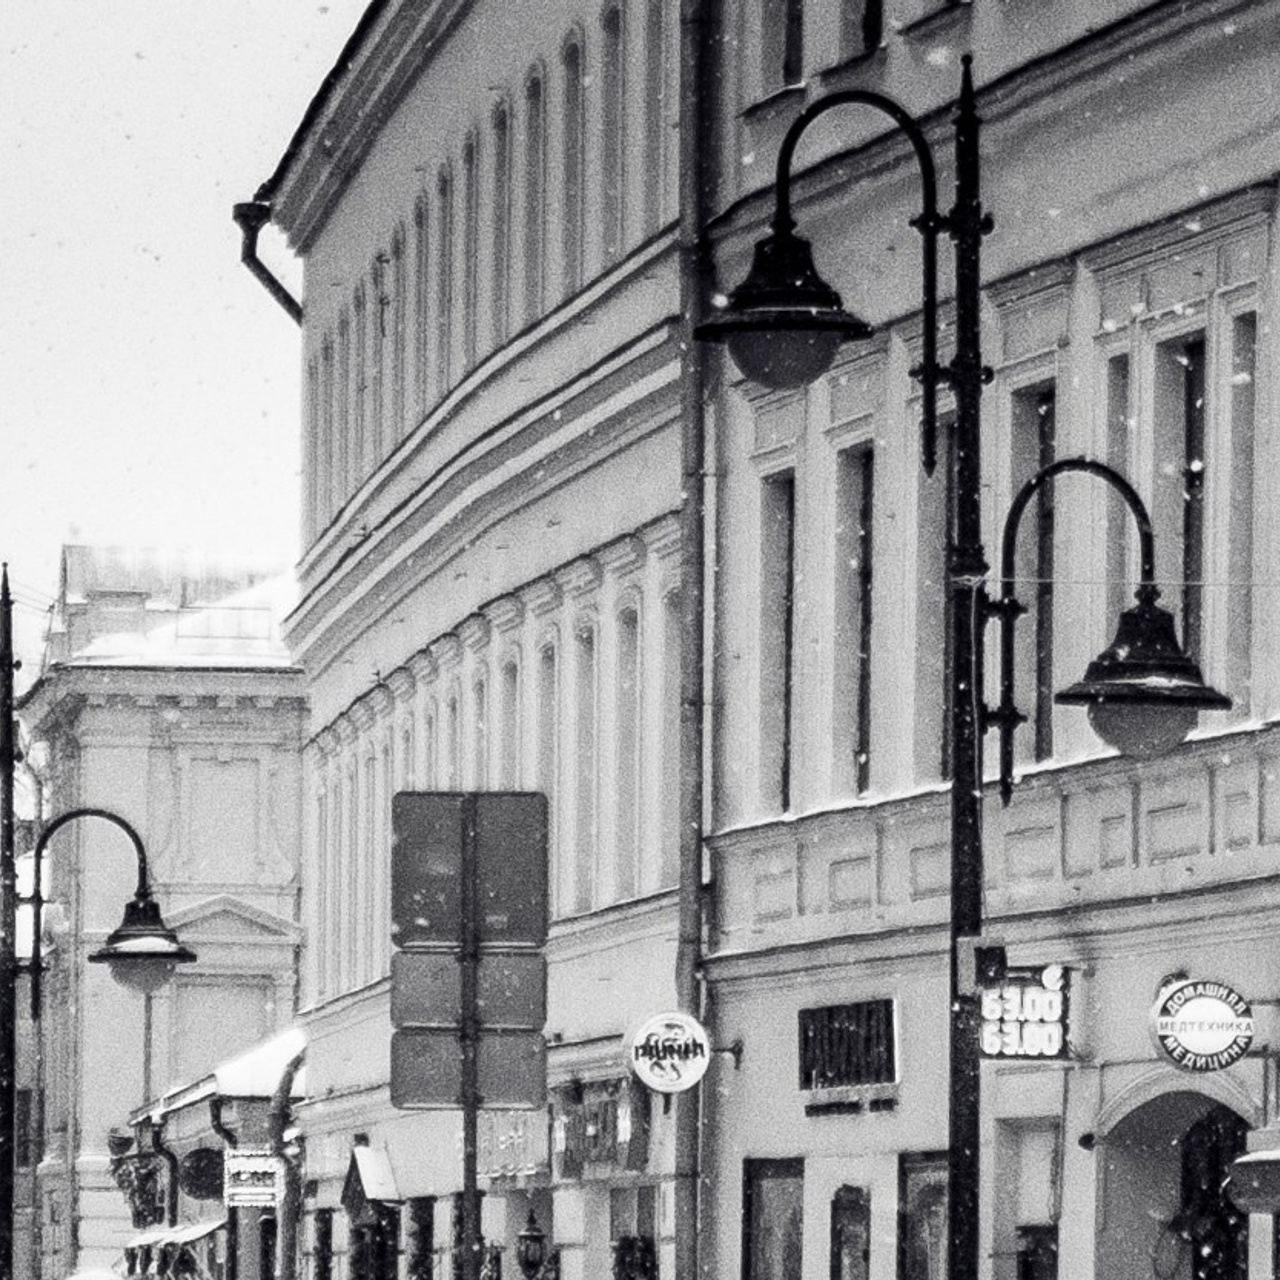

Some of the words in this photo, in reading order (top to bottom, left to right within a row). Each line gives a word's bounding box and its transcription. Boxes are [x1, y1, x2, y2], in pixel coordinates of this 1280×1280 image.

[1166, 983, 1247, 1015] ДОМАШНЯЯ
[1159, 1020, 1253, 1033] МЕДТЕХНИКА
[1163, 1035, 1249, 1069] МЕДИЦИНА
